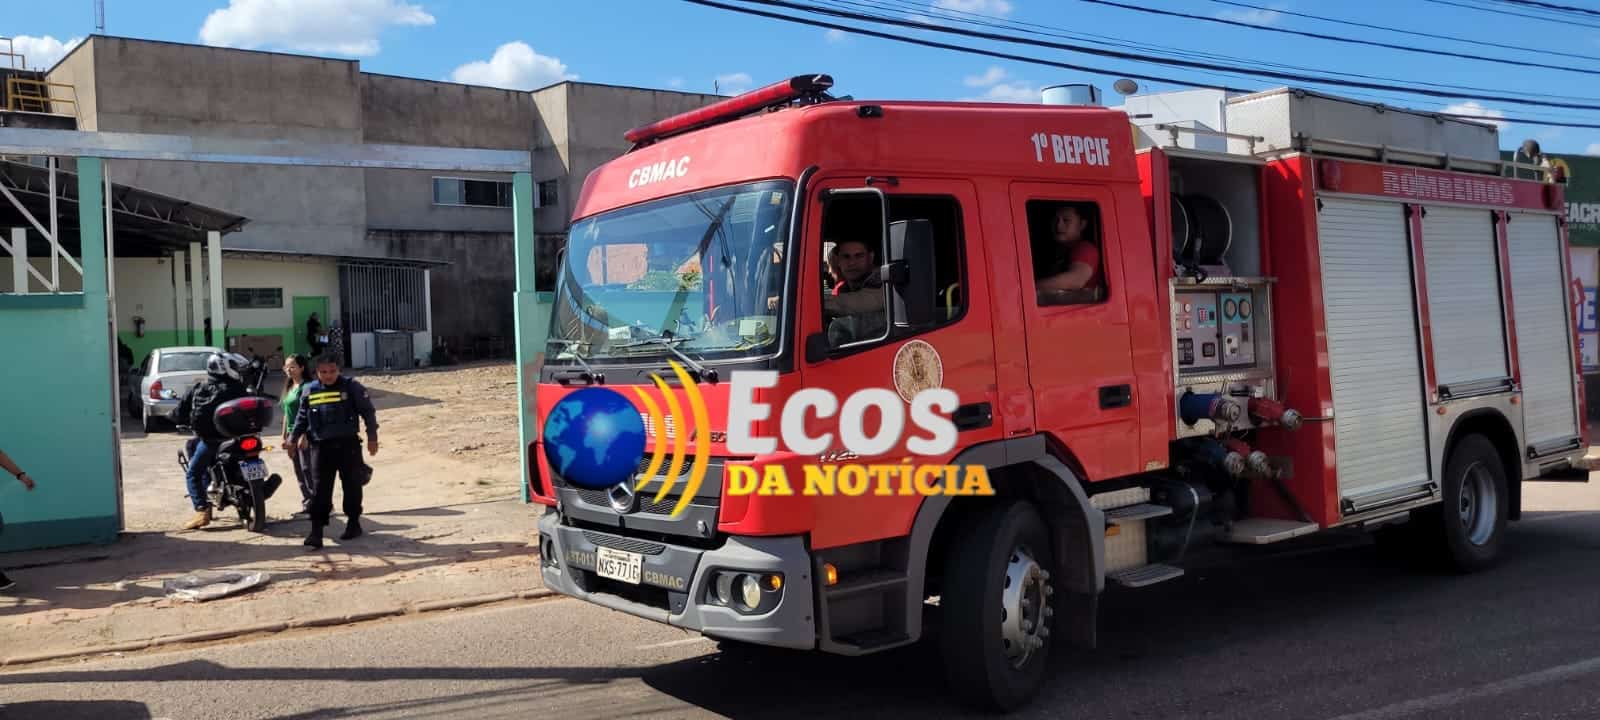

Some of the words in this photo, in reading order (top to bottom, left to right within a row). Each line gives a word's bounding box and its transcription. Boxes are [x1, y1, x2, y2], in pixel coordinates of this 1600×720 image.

[1051, 134, 1110, 167] BEPCIF
[628, 155, 691, 189] CBMAC
[1383, 171, 1514, 205] BOMBEIROS
[645, 570, 684, 589] CBMAC
